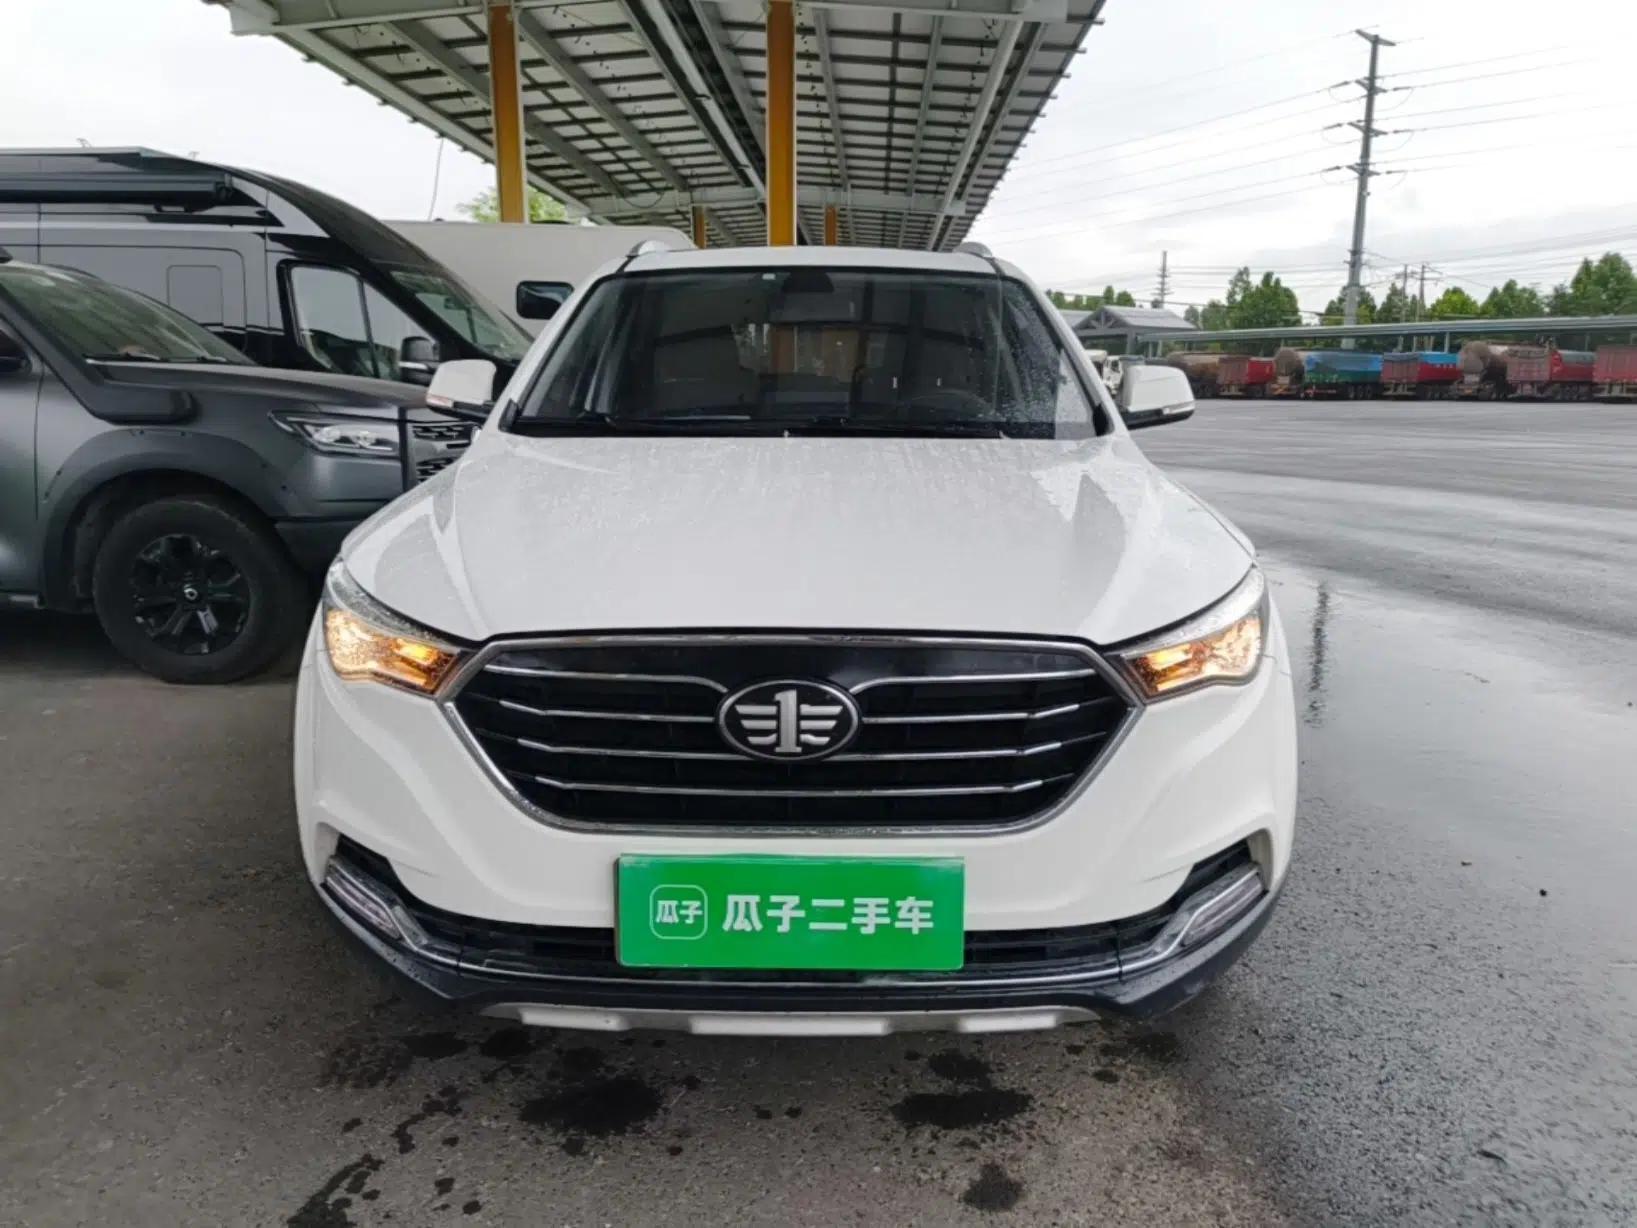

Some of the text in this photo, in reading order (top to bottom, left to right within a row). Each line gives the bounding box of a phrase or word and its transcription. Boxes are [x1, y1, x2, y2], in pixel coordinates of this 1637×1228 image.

[655, 900, 703, 924] 瓜子
[722, 894, 935, 934] 瓜子二手车
